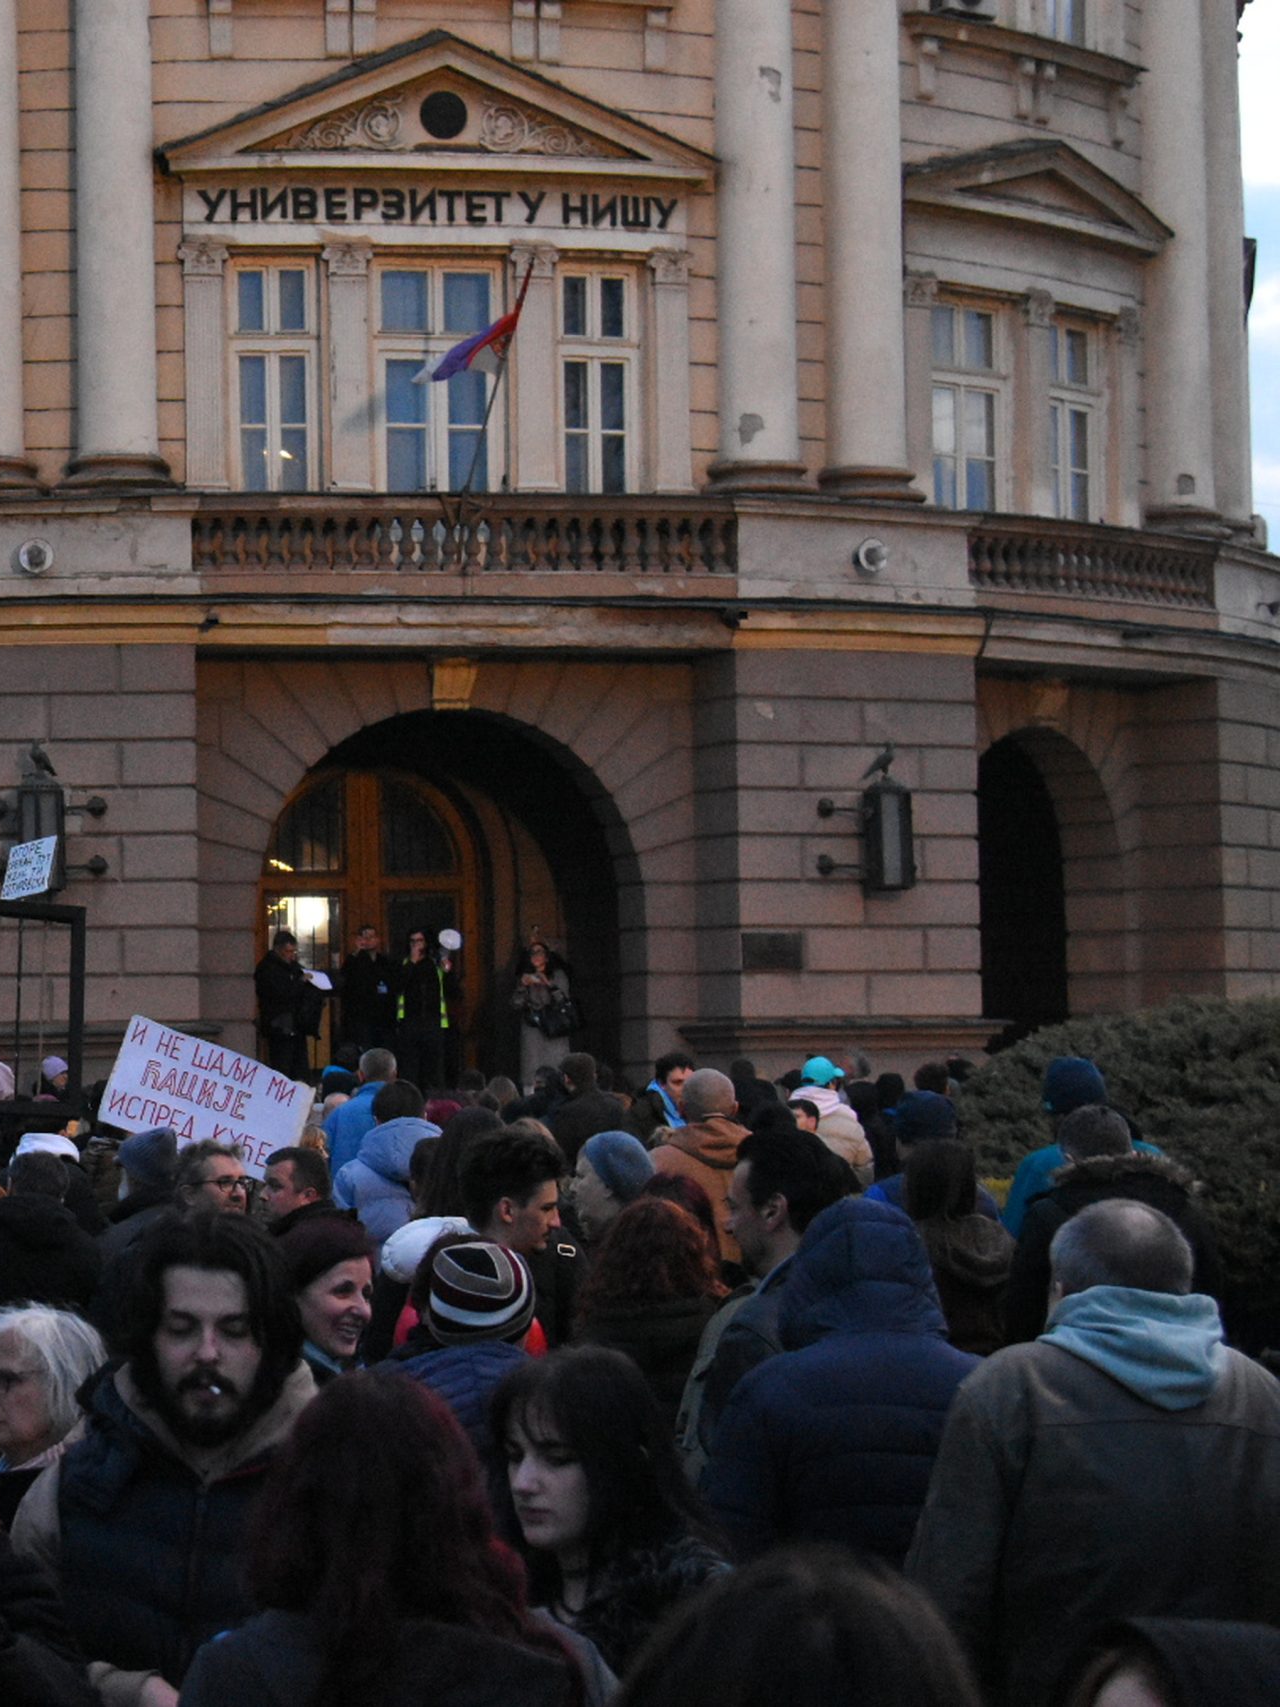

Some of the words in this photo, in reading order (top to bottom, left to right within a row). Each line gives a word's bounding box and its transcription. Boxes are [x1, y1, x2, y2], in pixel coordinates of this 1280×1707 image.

[197, 186, 511, 224] УНИВЕРЗИТЕТ
[516, 190, 547, 224] У
[561, 191, 679, 230] НИШУ
[130, 1020, 148, 1046] И
[155, 1030, 185, 1061] НЕ
[190, 1043, 259, 1088] ШАЉИ
[265, 1075, 297, 1108] МИ
[108, 1089, 195, 1139] ИСПРЕД
